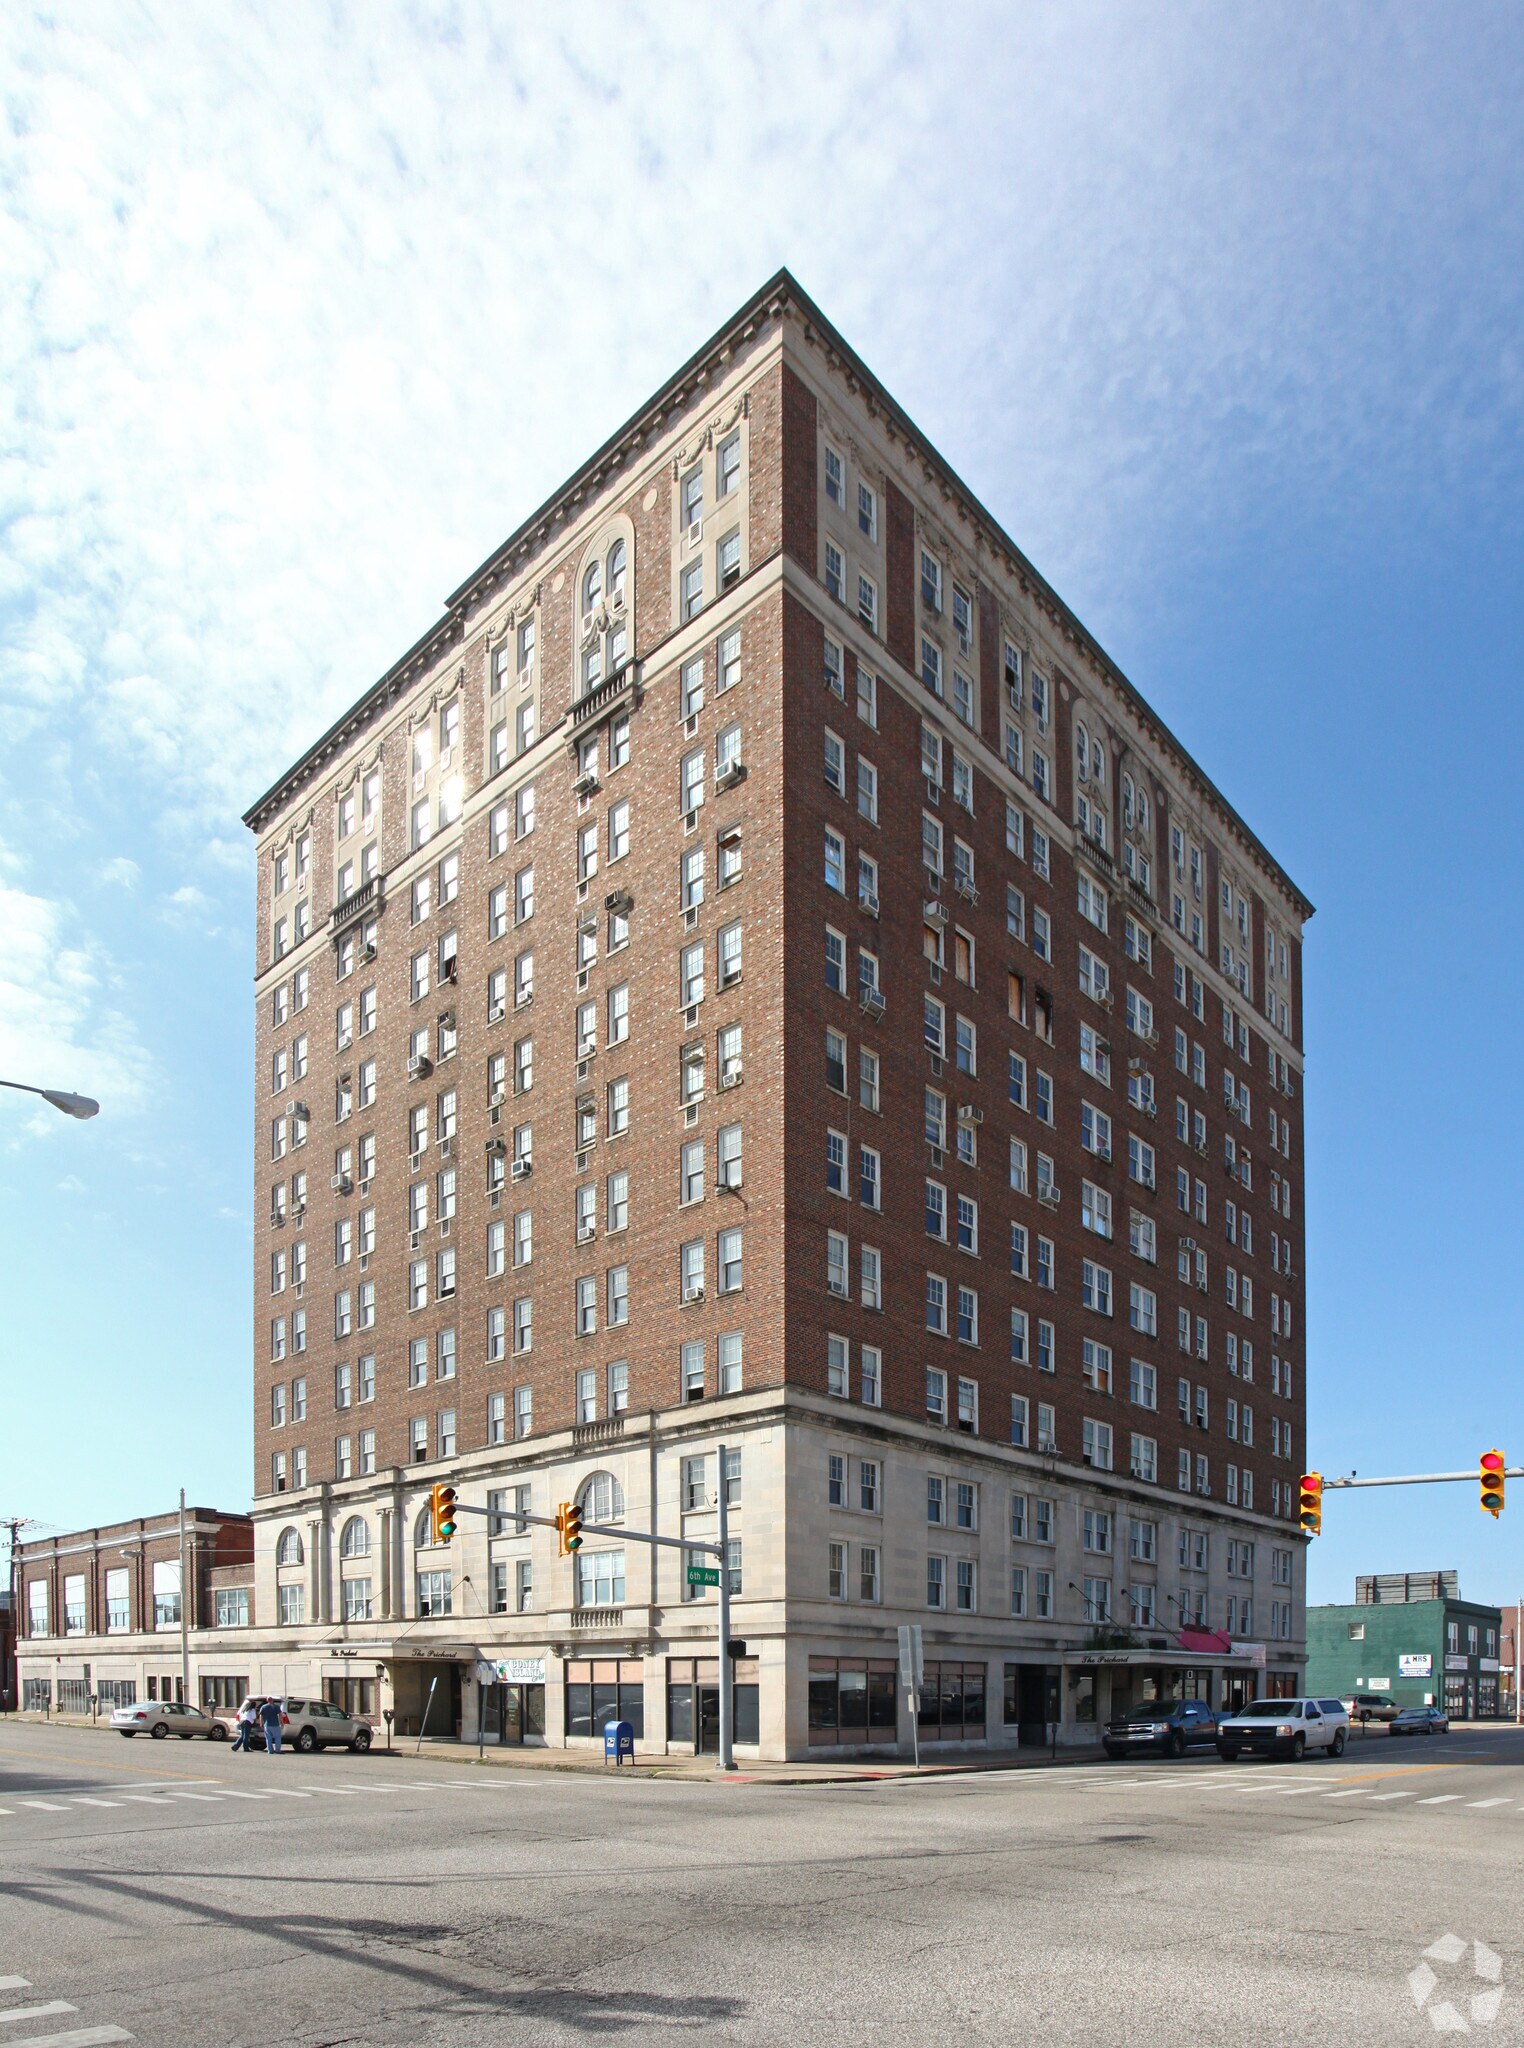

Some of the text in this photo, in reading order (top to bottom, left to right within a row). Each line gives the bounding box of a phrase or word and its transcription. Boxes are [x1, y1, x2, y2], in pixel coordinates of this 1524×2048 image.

[689, 1571, 716, 1582] 6th Ave
[412, 1648, 457, 1658] The Prichard
[1412, 1655, 1427, 1663] HRS
[512, 1660, 541, 1669] CONEY
